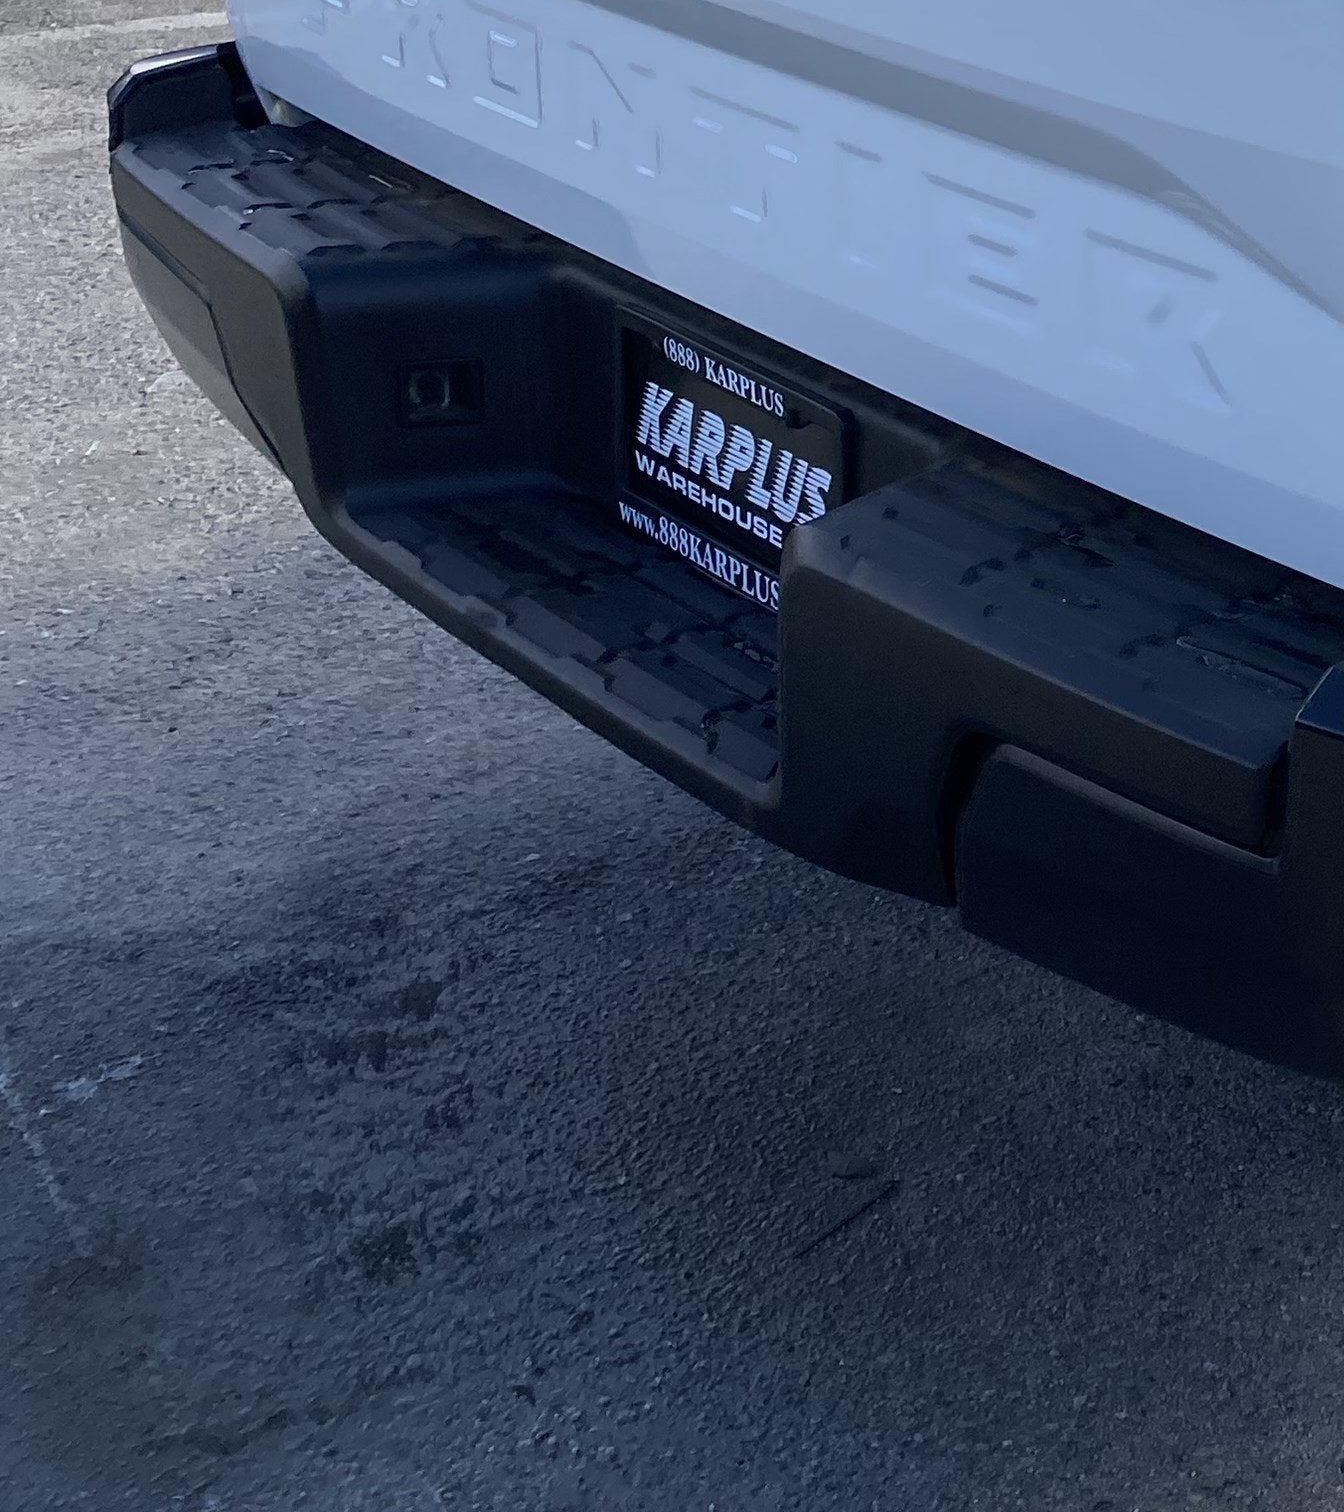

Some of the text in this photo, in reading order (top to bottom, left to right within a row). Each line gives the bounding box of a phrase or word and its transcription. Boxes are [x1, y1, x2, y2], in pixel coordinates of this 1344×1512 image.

[663, 336, 785, 417] (888) KARPLUS
[635, 449, 783, 548] WAREHOUSE
[636, 381, 832, 524] KARPLUS
